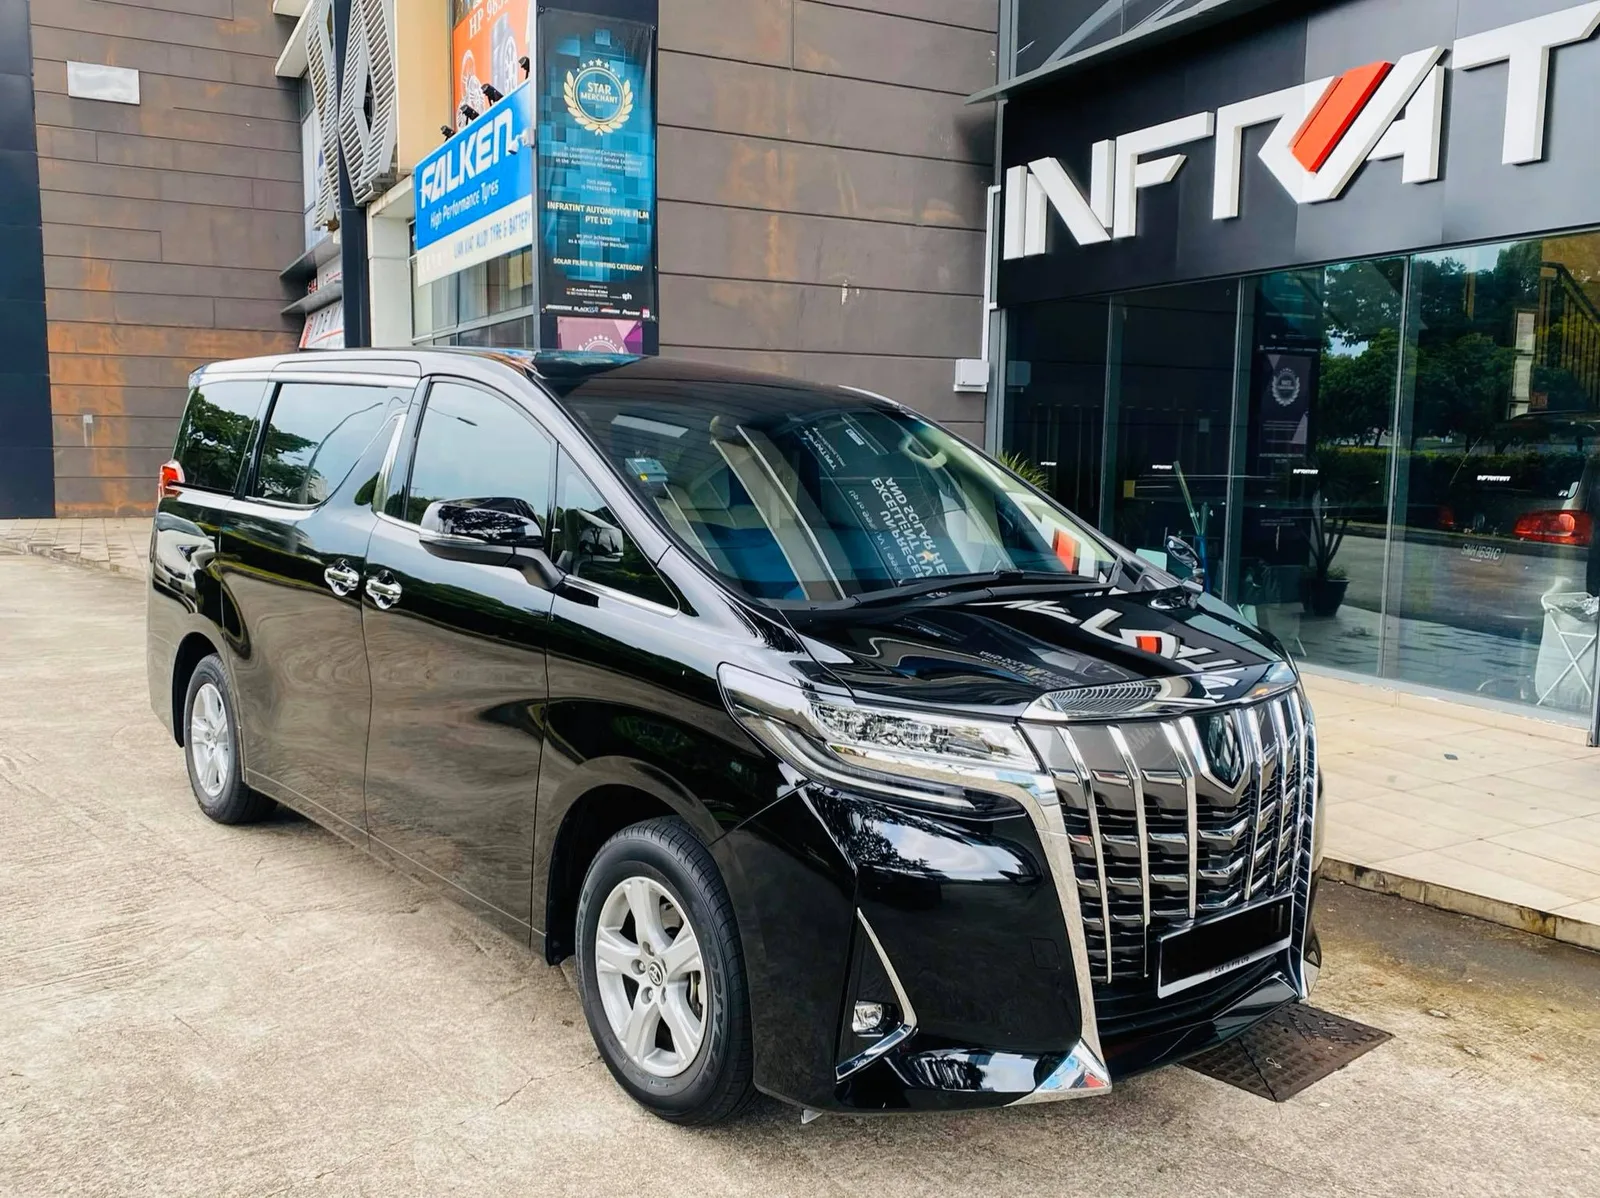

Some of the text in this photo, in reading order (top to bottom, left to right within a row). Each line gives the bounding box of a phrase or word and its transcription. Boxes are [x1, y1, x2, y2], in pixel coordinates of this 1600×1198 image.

[468, 8, 485, 40] HP
[587, 82, 612, 95] STAR
[580, 92, 618, 104] MERCHANT
[419, 107, 515, 209] FALKEN
[430, 179, 499, 231] High Performance Tyres
[547, 202, 649, 220] INFRATINT AUTOMOTIVE FILM
[585, 215, 613, 225] PTE LTD
[553, 257, 571, 265] SOLAR
[572, 259, 588, 267] FILMS
[616, 262, 643, 272] CATEGORY
